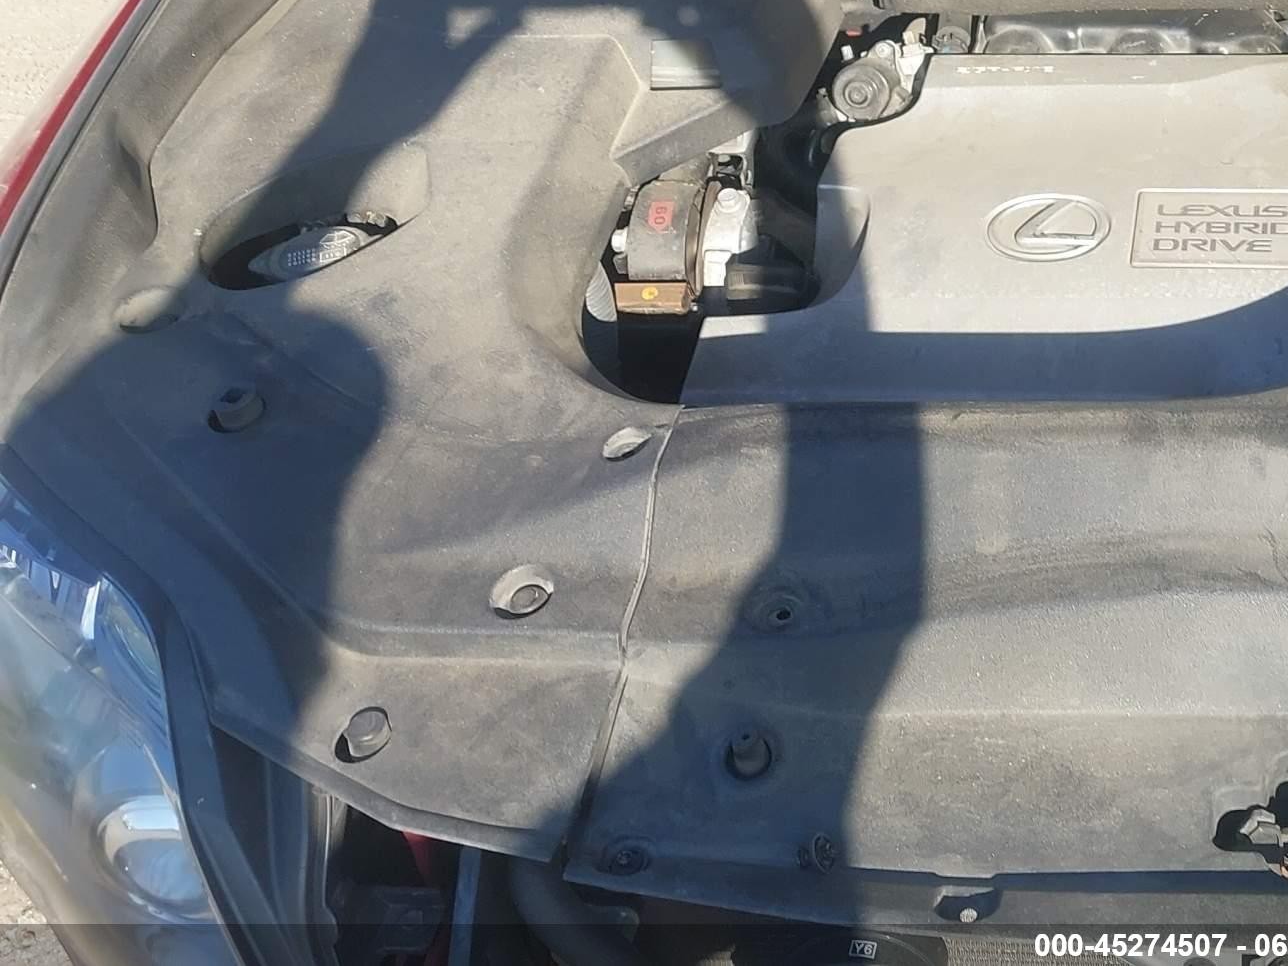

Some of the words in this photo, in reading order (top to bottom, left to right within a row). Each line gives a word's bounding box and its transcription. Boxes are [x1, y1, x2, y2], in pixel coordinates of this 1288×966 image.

[1157, 204, 1288, 218] LEXUS
[1152, 238, 1273, 252] DRIVE
[854, 940, 873, 955] Y6
